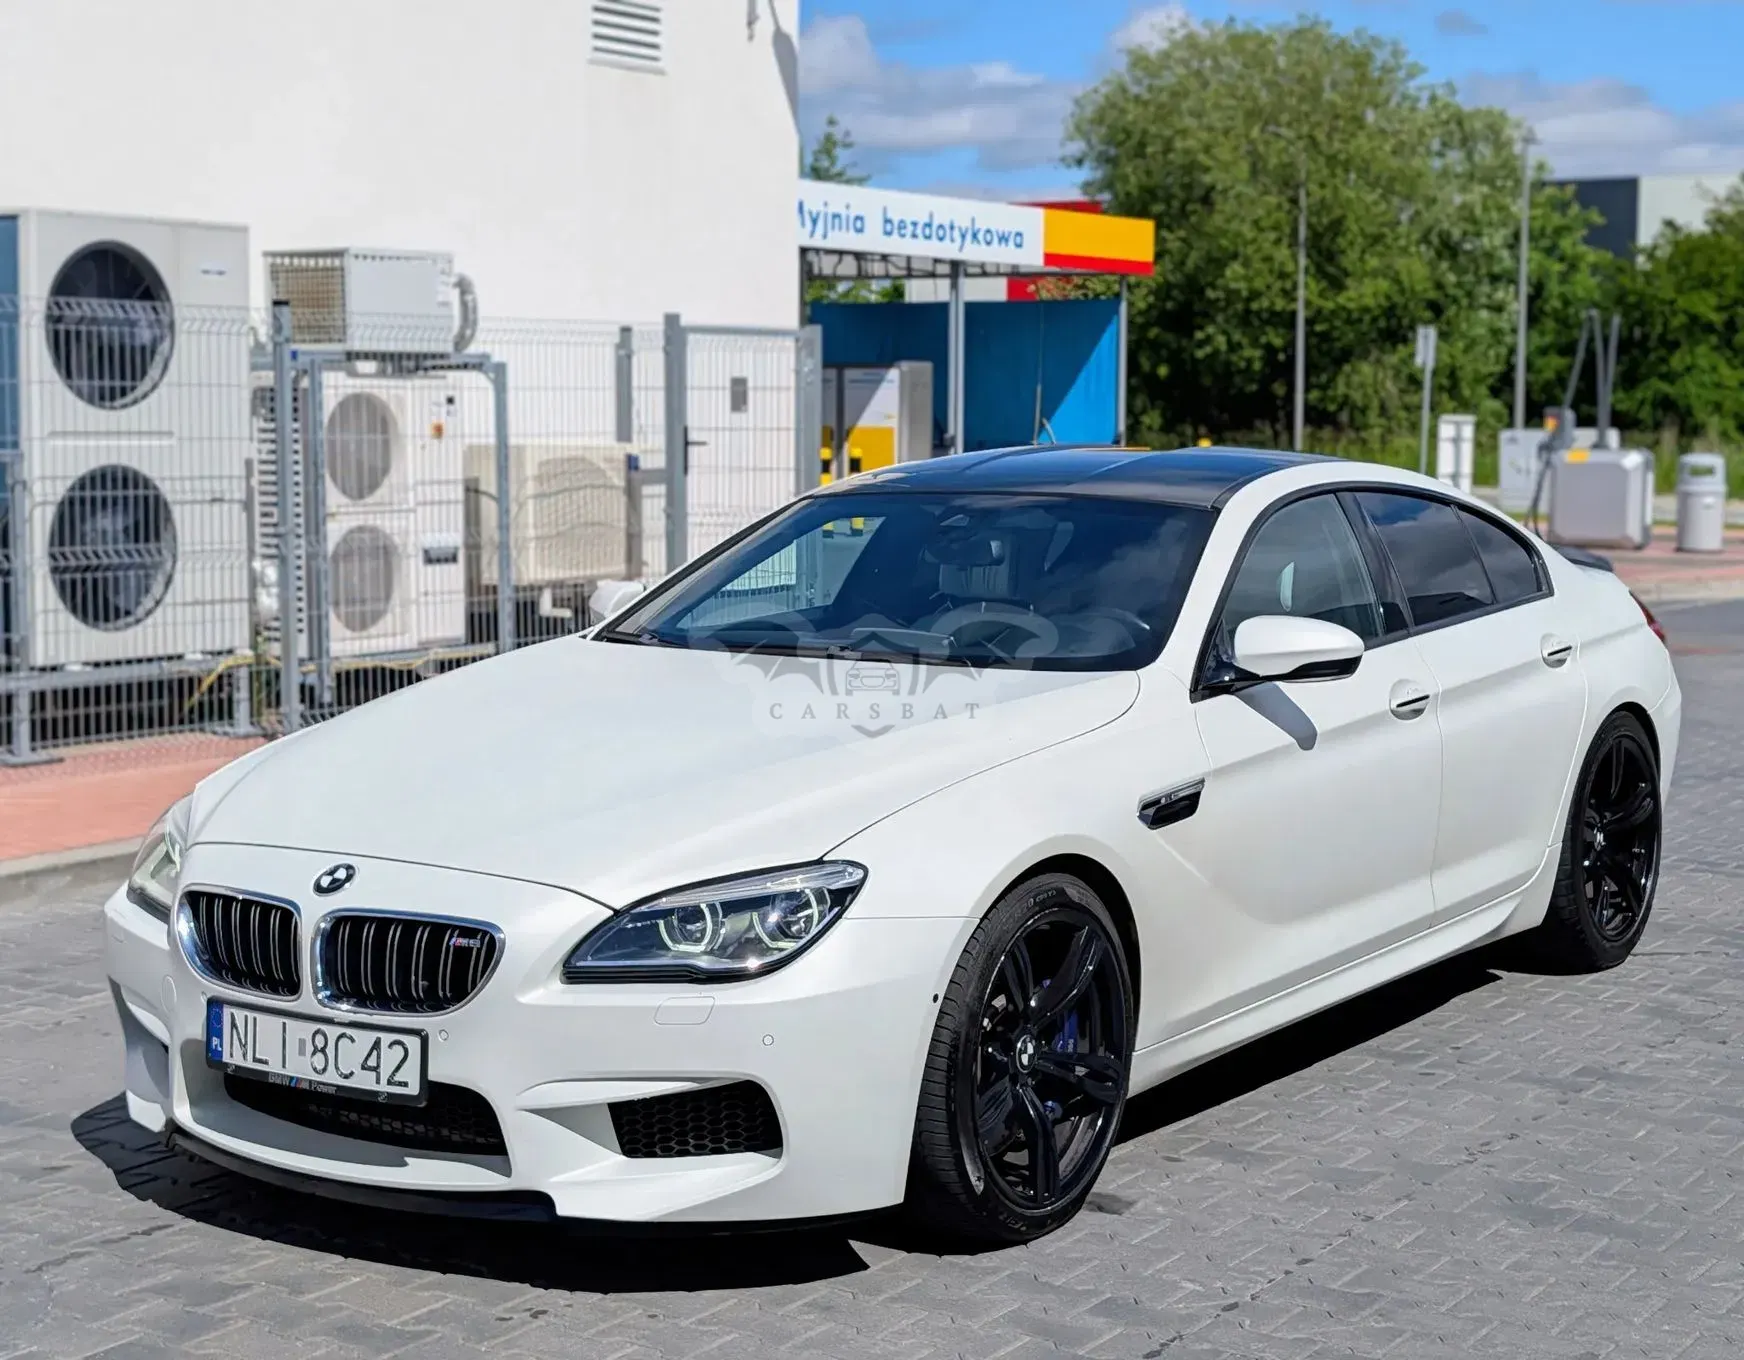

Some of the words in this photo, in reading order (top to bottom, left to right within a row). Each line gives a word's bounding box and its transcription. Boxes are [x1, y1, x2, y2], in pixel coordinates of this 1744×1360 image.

[883, 205, 1024, 252] bezdotykowa
[212, 1036, 222, 1051] PL
[229, 1011, 287, 1069] NLI
[310, 1027, 409, 1088] 8C42
